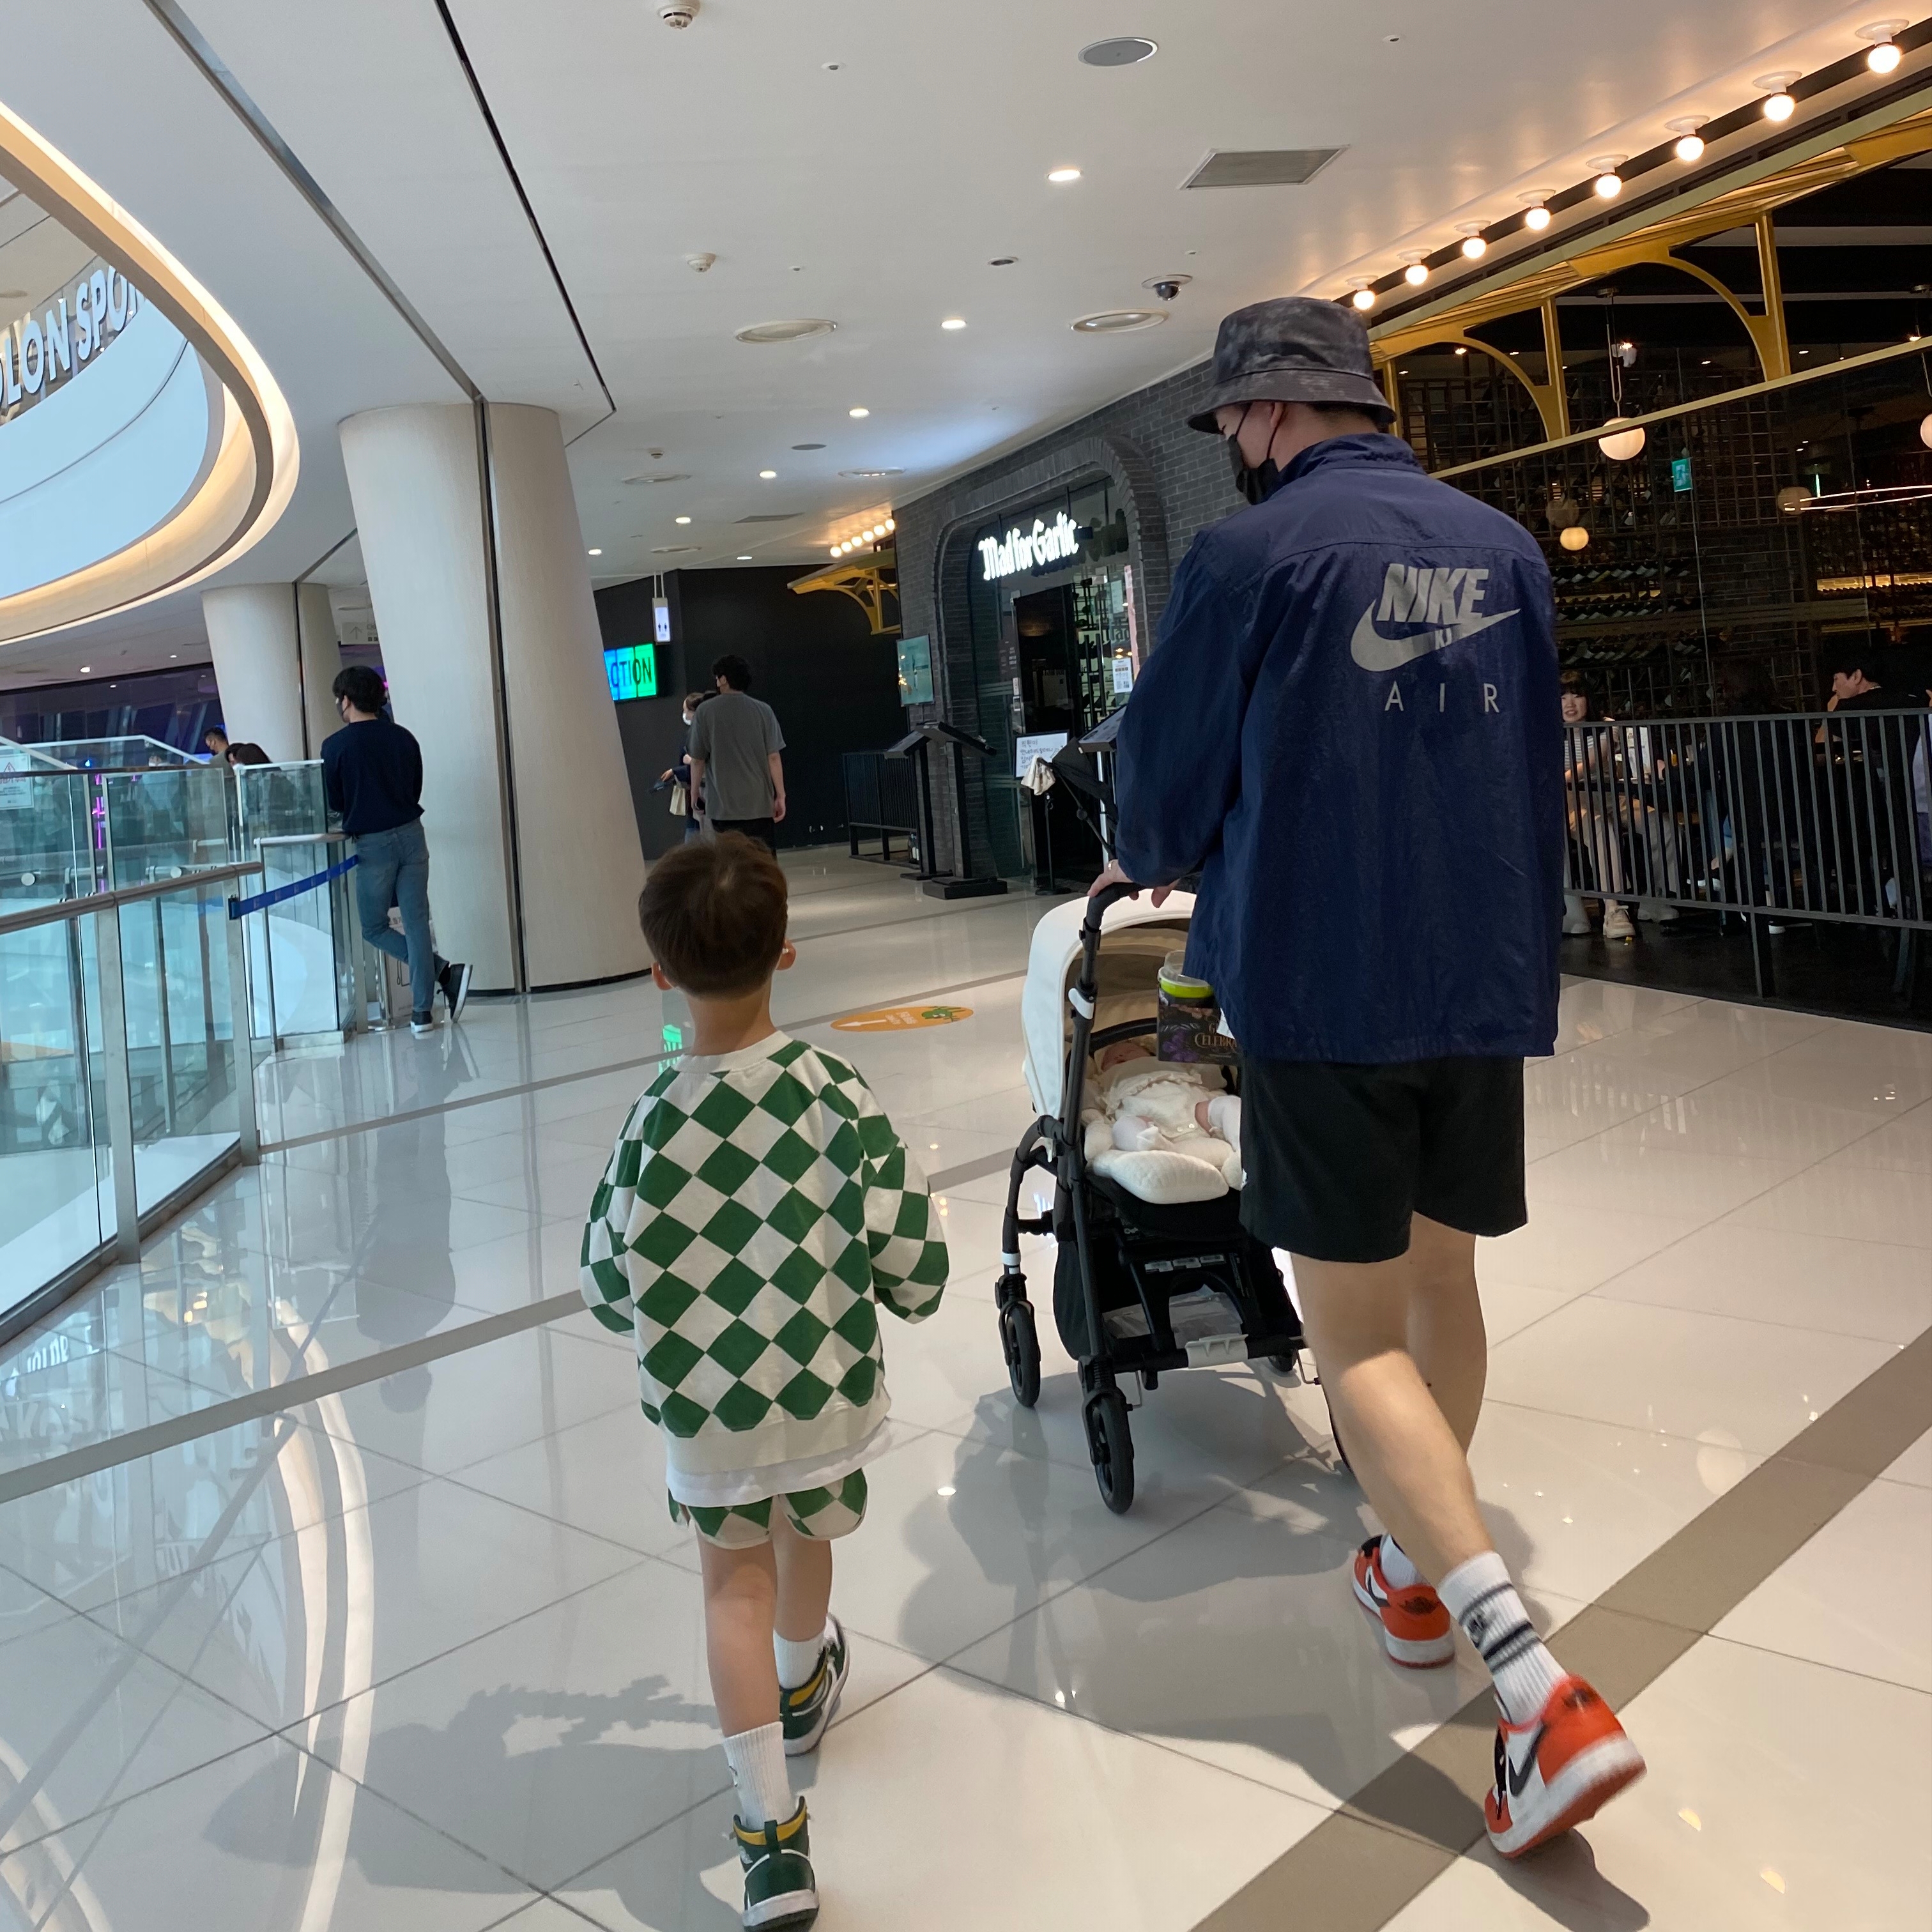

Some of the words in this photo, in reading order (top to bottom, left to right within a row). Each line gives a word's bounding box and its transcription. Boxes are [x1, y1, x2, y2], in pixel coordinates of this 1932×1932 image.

[0, 296, 70, 406] LON
[978, 531, 1016, 581] Mad
[1032, 511, 1079, 565] Garlic
[1376, 563, 1489, 625] NIKE
[1384, 680, 1499, 713] AIR
